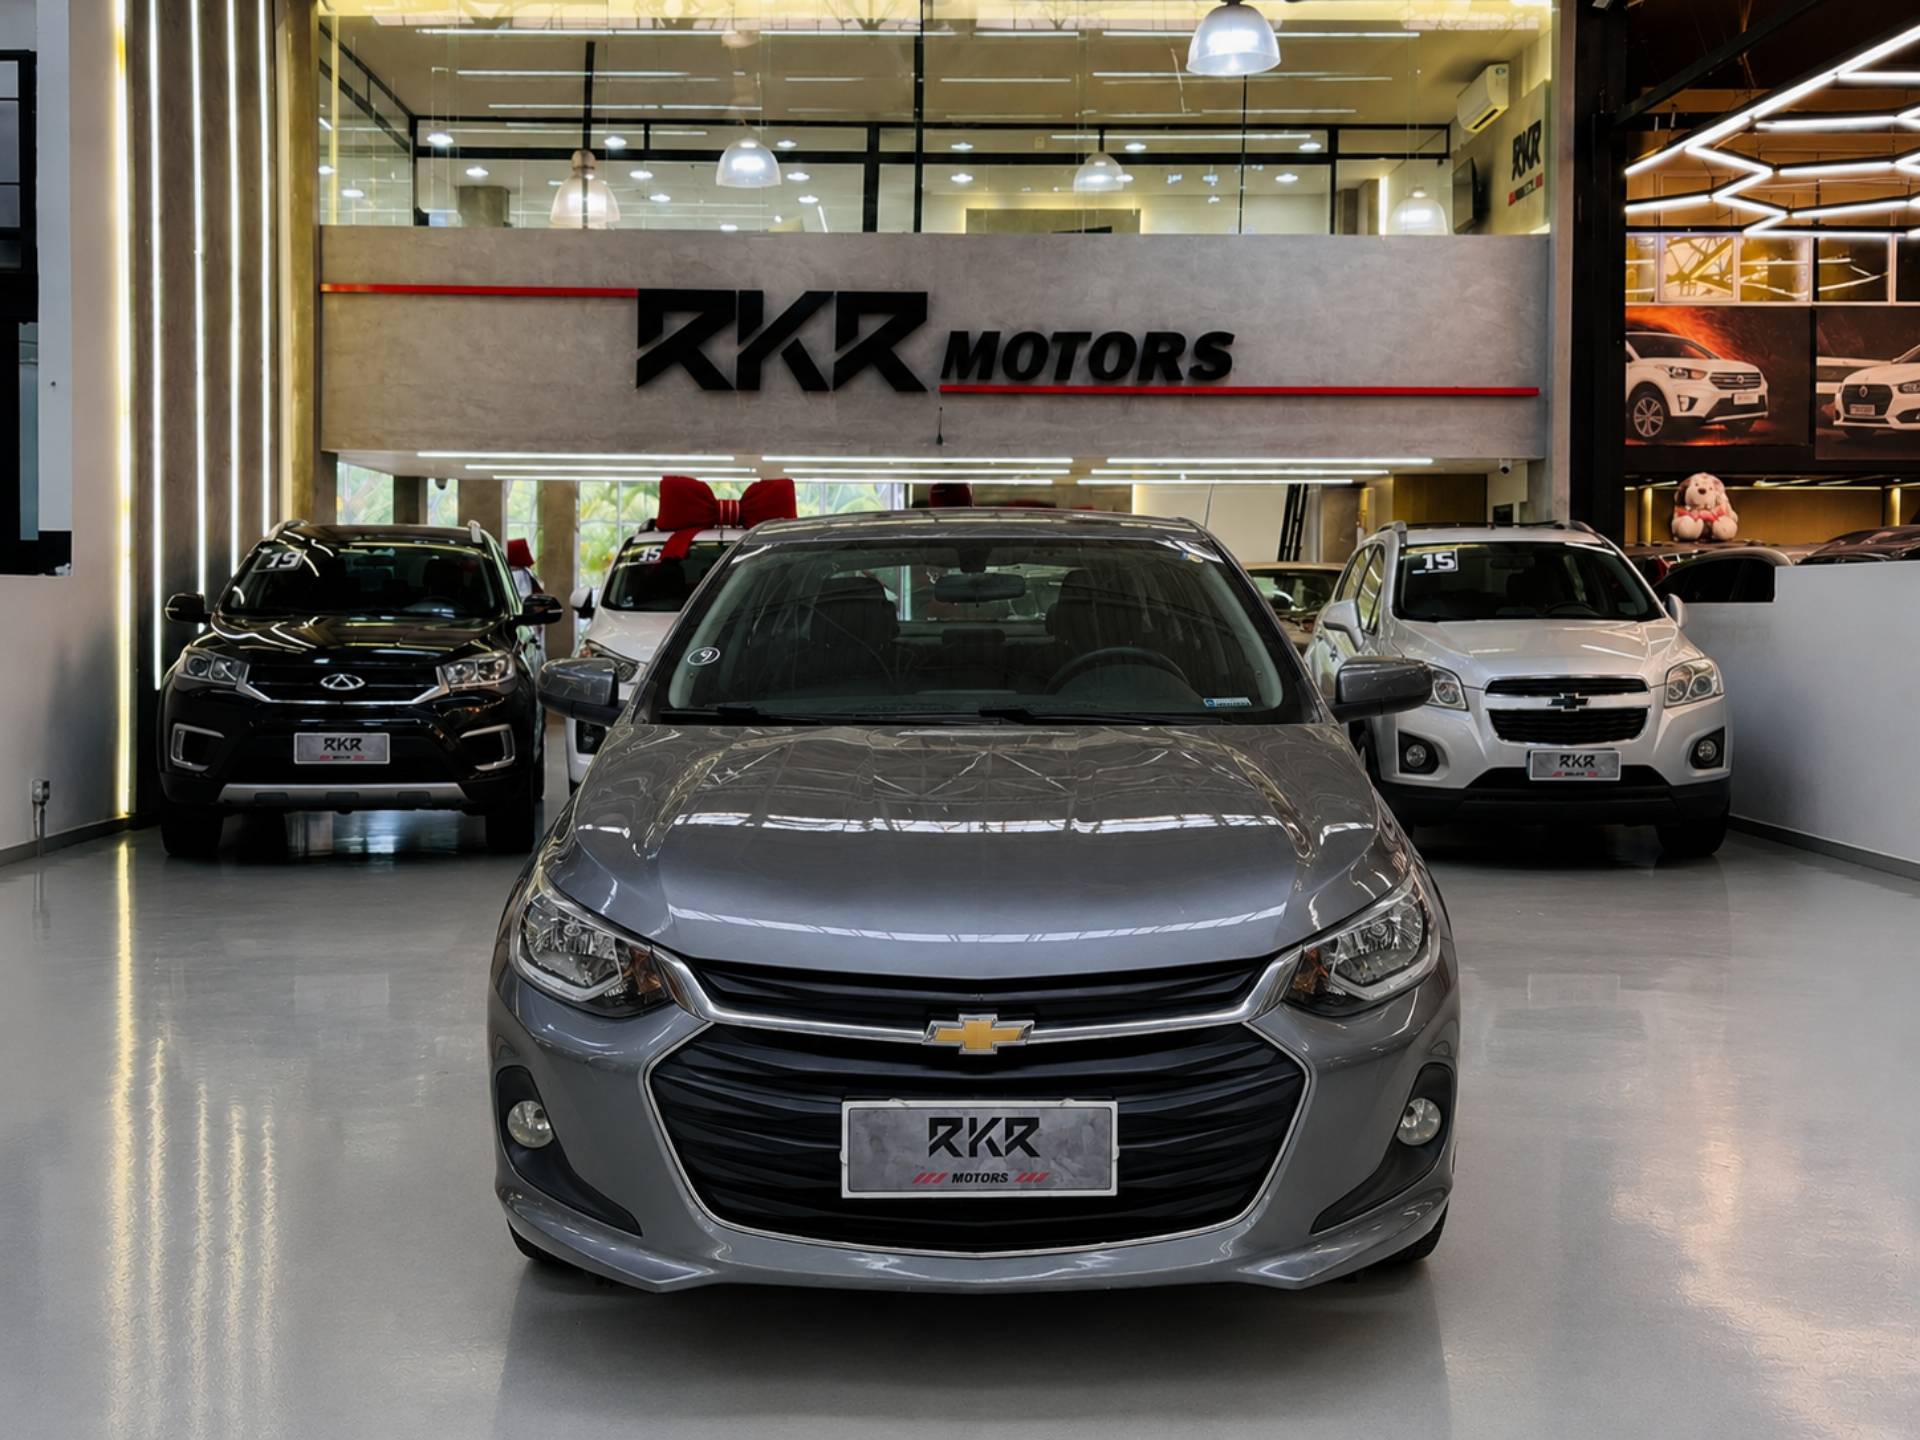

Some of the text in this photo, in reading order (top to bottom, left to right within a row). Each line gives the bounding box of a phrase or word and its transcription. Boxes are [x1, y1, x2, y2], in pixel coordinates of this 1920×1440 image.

[1511, 119, 1542, 181] RKR
[636, 289, 1234, 391] RKR MOTORS
[266, 552, 302, 568] 19
[1422, 552, 1455, 570] 15
[323, 737, 362, 751] RKR
[1559, 754, 1595, 768] RKR
[928, 1117, 1040, 1158] RKR
[952, 1172, 1009, 1184] MOTORS
